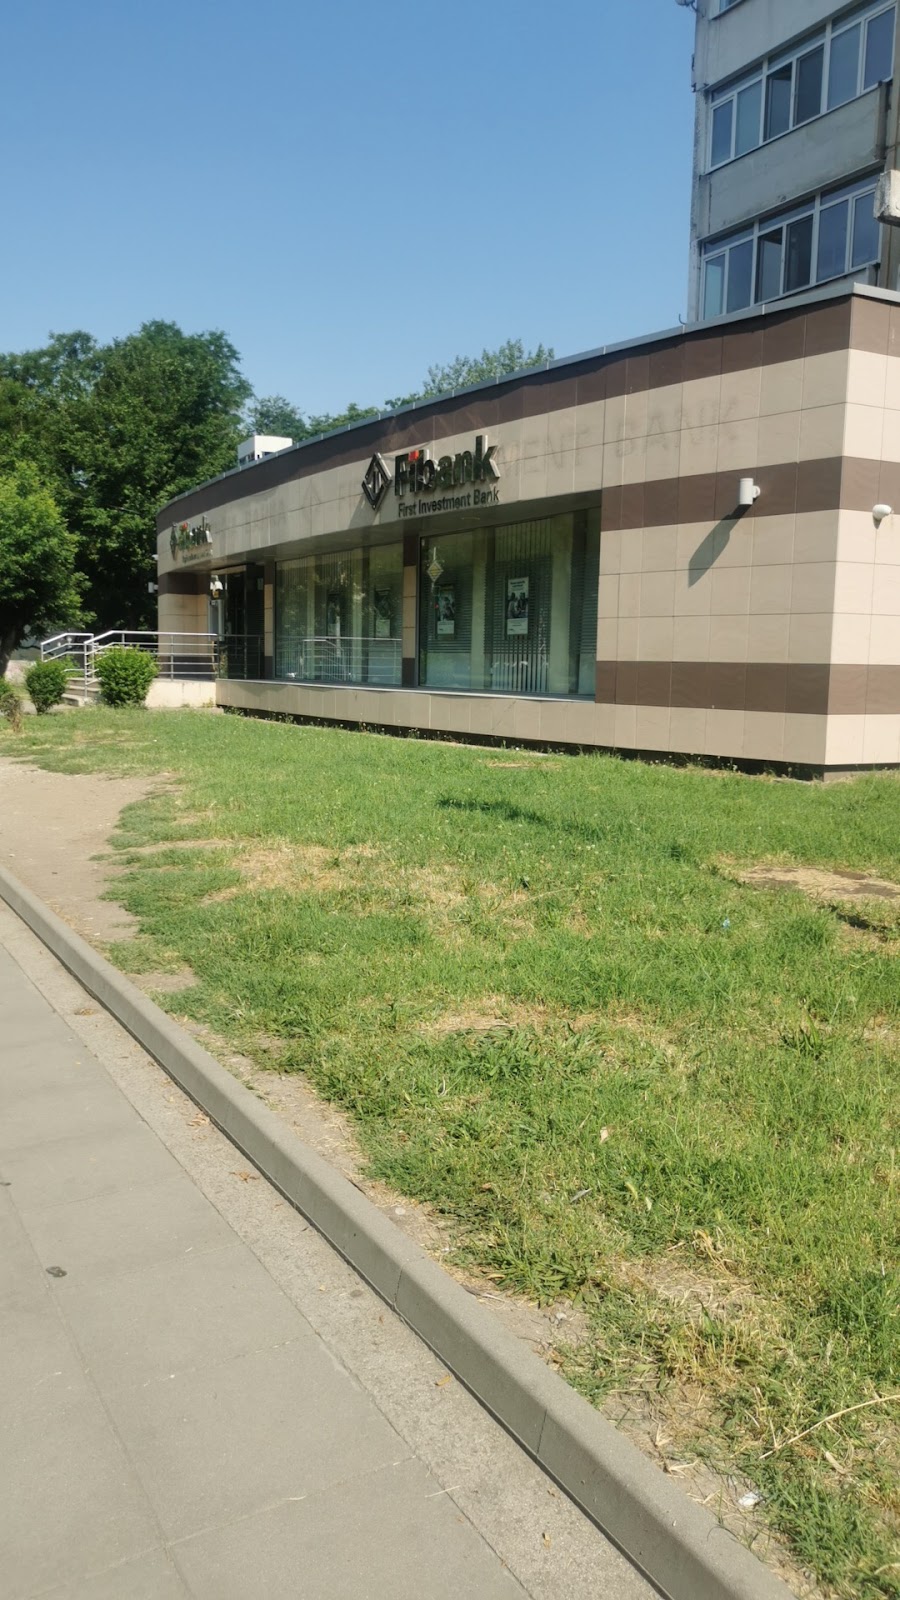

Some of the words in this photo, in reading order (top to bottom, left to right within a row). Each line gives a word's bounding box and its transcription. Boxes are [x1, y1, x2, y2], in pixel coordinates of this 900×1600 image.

[394, 435, 501, 497] Fibank
[398, 502, 416, 518] First
[418, 493, 471, 514] Investment
[473, 487, 499, 506] Bank
